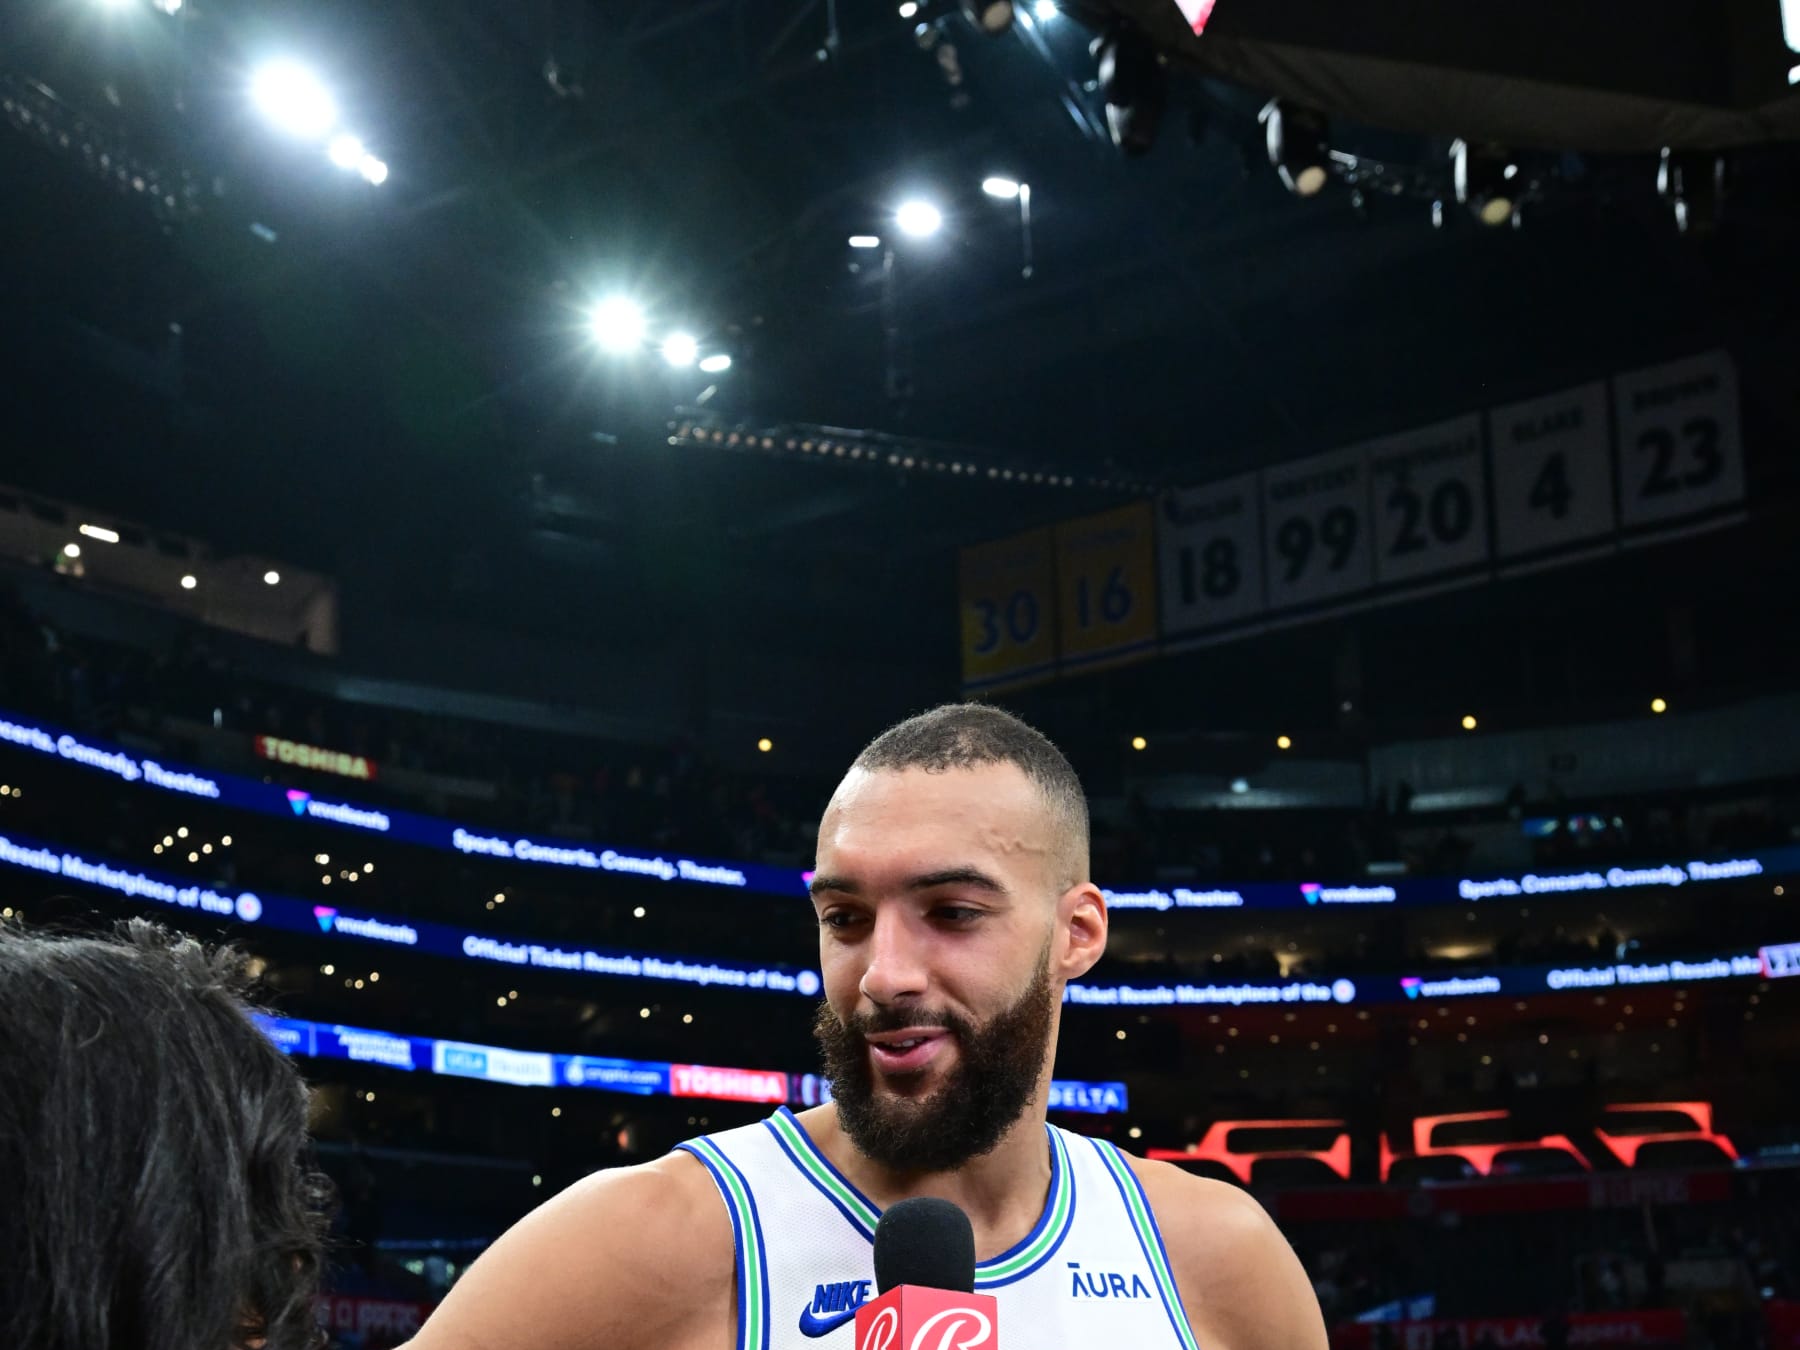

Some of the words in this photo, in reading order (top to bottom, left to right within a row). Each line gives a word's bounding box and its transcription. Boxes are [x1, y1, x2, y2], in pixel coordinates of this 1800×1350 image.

[1635, 417, 1723, 498] 23
[1529, 451, 1573, 519] 4
[1275, 506, 1358, 581] 99
[1387, 479, 1473, 556] 20
[1077, 565, 1133, 628] 16
[1178, 538, 1240, 606] 18
[973, 587, 1039, 655] 30
[262, 736, 370, 779] TOSHIBA
[61, 853, 178, 903] Marketplace
[463, 935, 529, 964] Official
[529, 945, 583, 970] Ticket
[582, 951, 642, 976] Resale
[641, 957, 747, 986] Marketplace
[746, 969, 767, 988] of
[766, 967, 796, 991] the
[1547, 966, 1616, 990] Official
[1615, 963, 1670, 983] Ticket
[1669, 958, 1731, 980] Resale
[1175, 984, 1281, 1006] Marketplace
[585, 1064, 663, 1086] crypto.com
[675, 1068, 782, 1100] TOSHIBA
[1047, 1087, 1120, 1107] DELTA
[812, 1280, 871, 1314] NIKE
